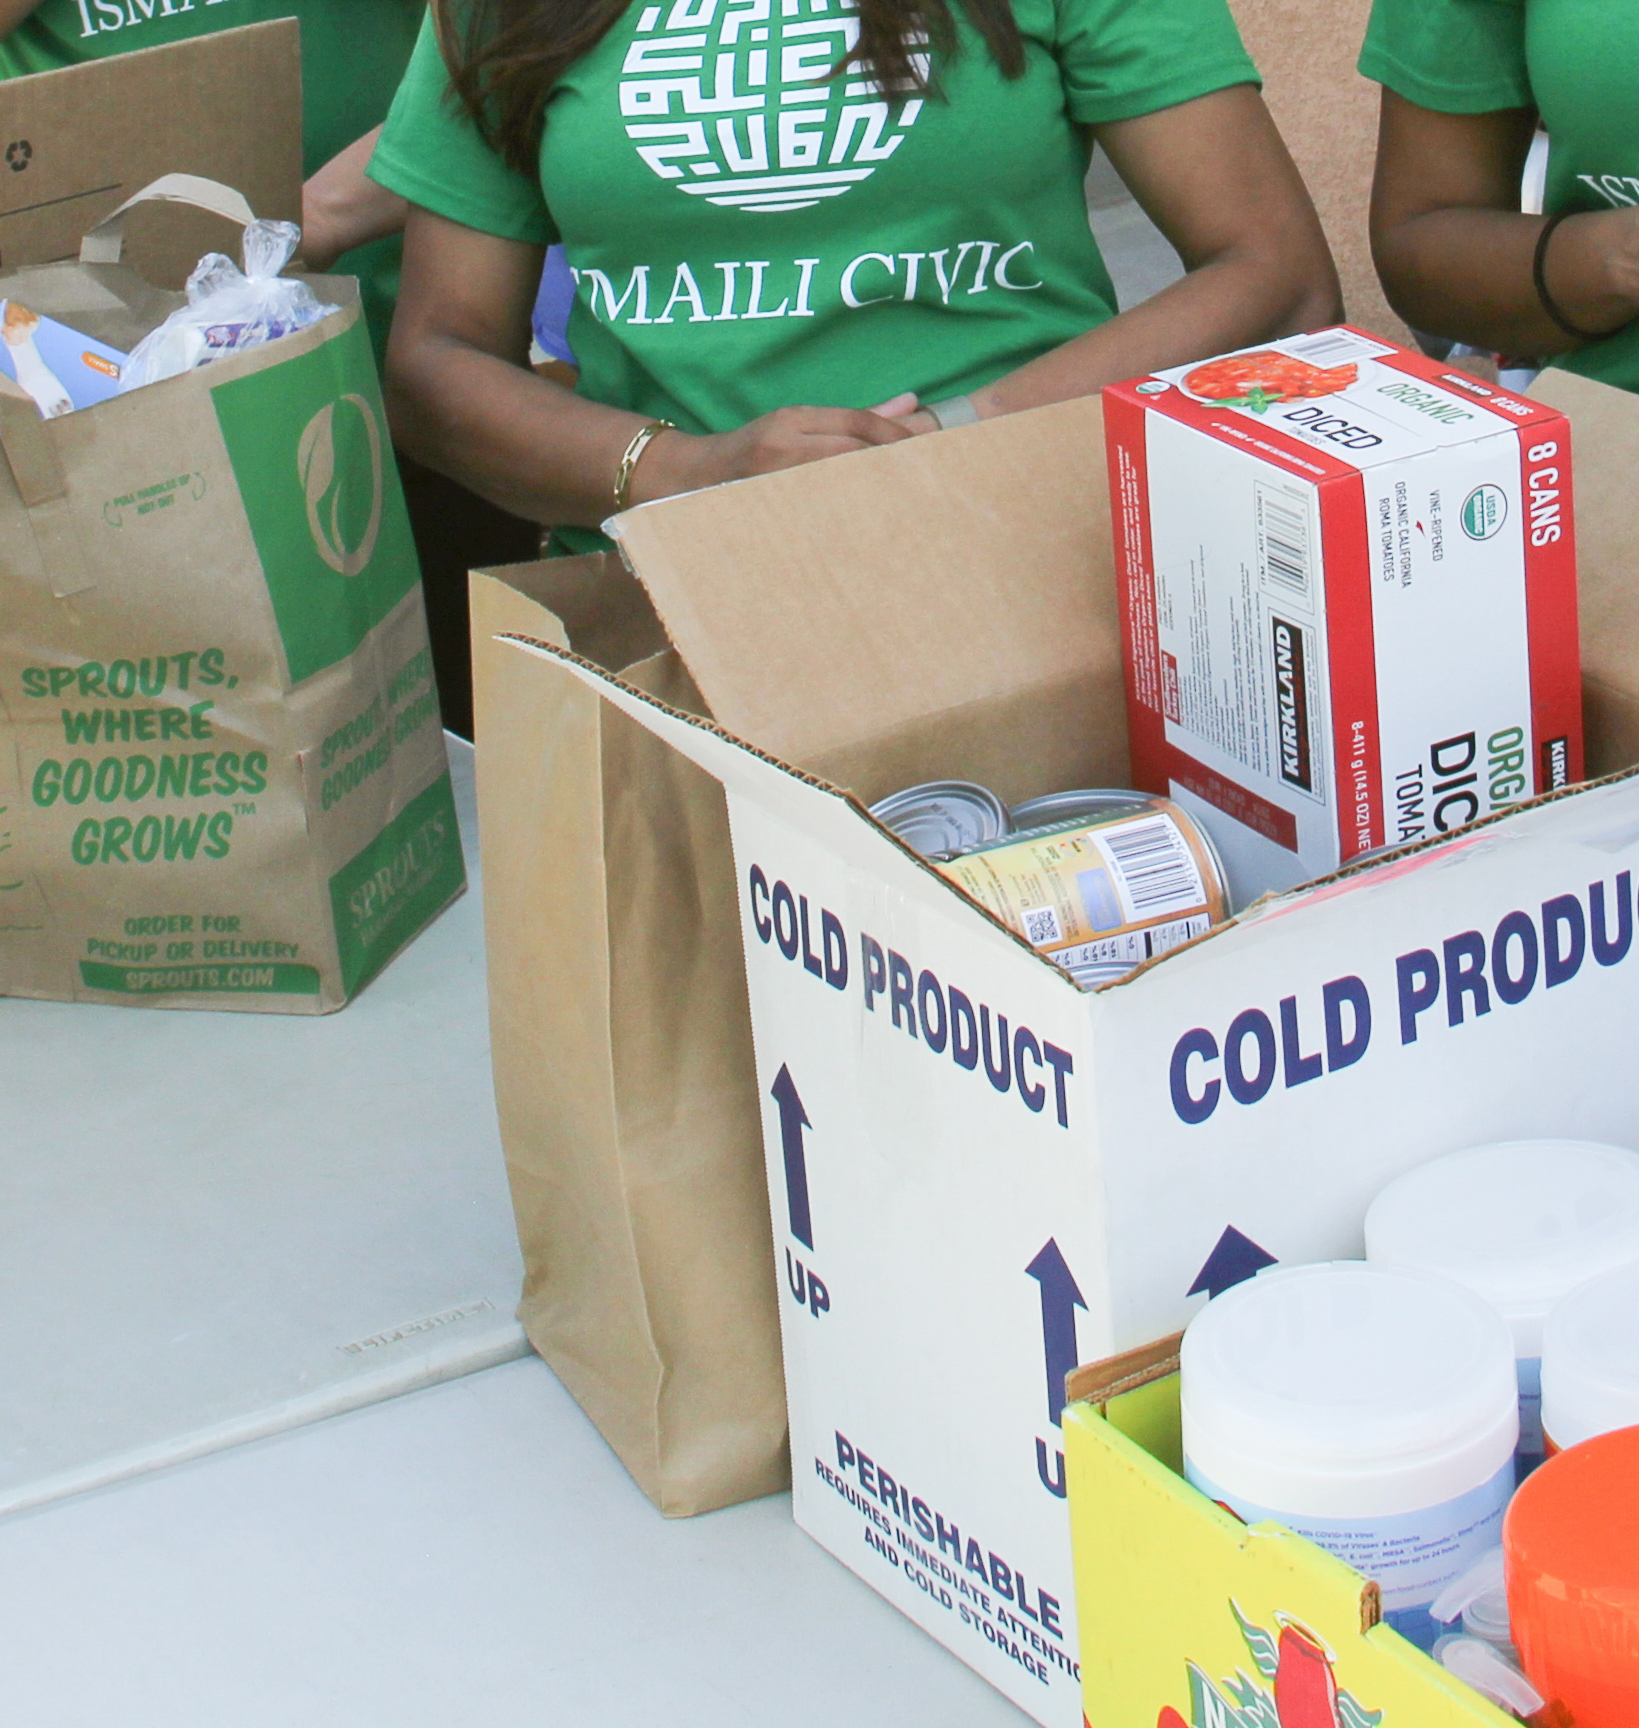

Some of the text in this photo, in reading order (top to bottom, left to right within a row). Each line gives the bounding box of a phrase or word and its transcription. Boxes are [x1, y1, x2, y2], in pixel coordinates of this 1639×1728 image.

[569, 241, 1043, 324] MAILI CIVIC
[1283, 406, 1383, 450] DICED
[1376, 382, 1474, 425] ORGANIC
[1430, 489, 1443, 562] VINE-RIPENED
[1486, 495, 1496, 526] USDA
[1527, 440, 1561, 548] 8 CANS
[1379, 498, 1394, 582] ROMA TOMATOES
[1395, 481, 1411, 589] ORGANIC CALIFORNIA
[22, 647, 239, 698] SPROUTS,
[1276, 624, 1298, 776] KIRKLAND
[62, 701, 214, 746] WHERE
[1351, 721, 1365, 756] 8-411
[32, 752, 268, 808] GOODNESS
[1350, 760, 1363, 769] g
[1353, 771, 1368, 801] (14.5
[1356, 803, 1370, 826] OZ)
[1395, 764, 1426, 842] TOMA
[87, 938, 299, 962] PICKUP OR DELIVERY
[124, 915, 241, 936] ORDER FOR
[126, 968, 275, 990] SPROUTS.COM
[750, 863, 849, 992] COLD
[860, 931, 1074, 1130] PRODUCT
[1169, 975, 1373, 1125] COLD
[786, 1247, 830, 1320] UP
[1035, 1435, 1067, 1500] U
[835, 1429, 1063, 1639] PERISHABLE
[814, 1456, 1081, 1683] REQUIRES IMMEDIATE ATTENTIO
[864, 1525, 1050, 1687] AND COLD STORAGE
